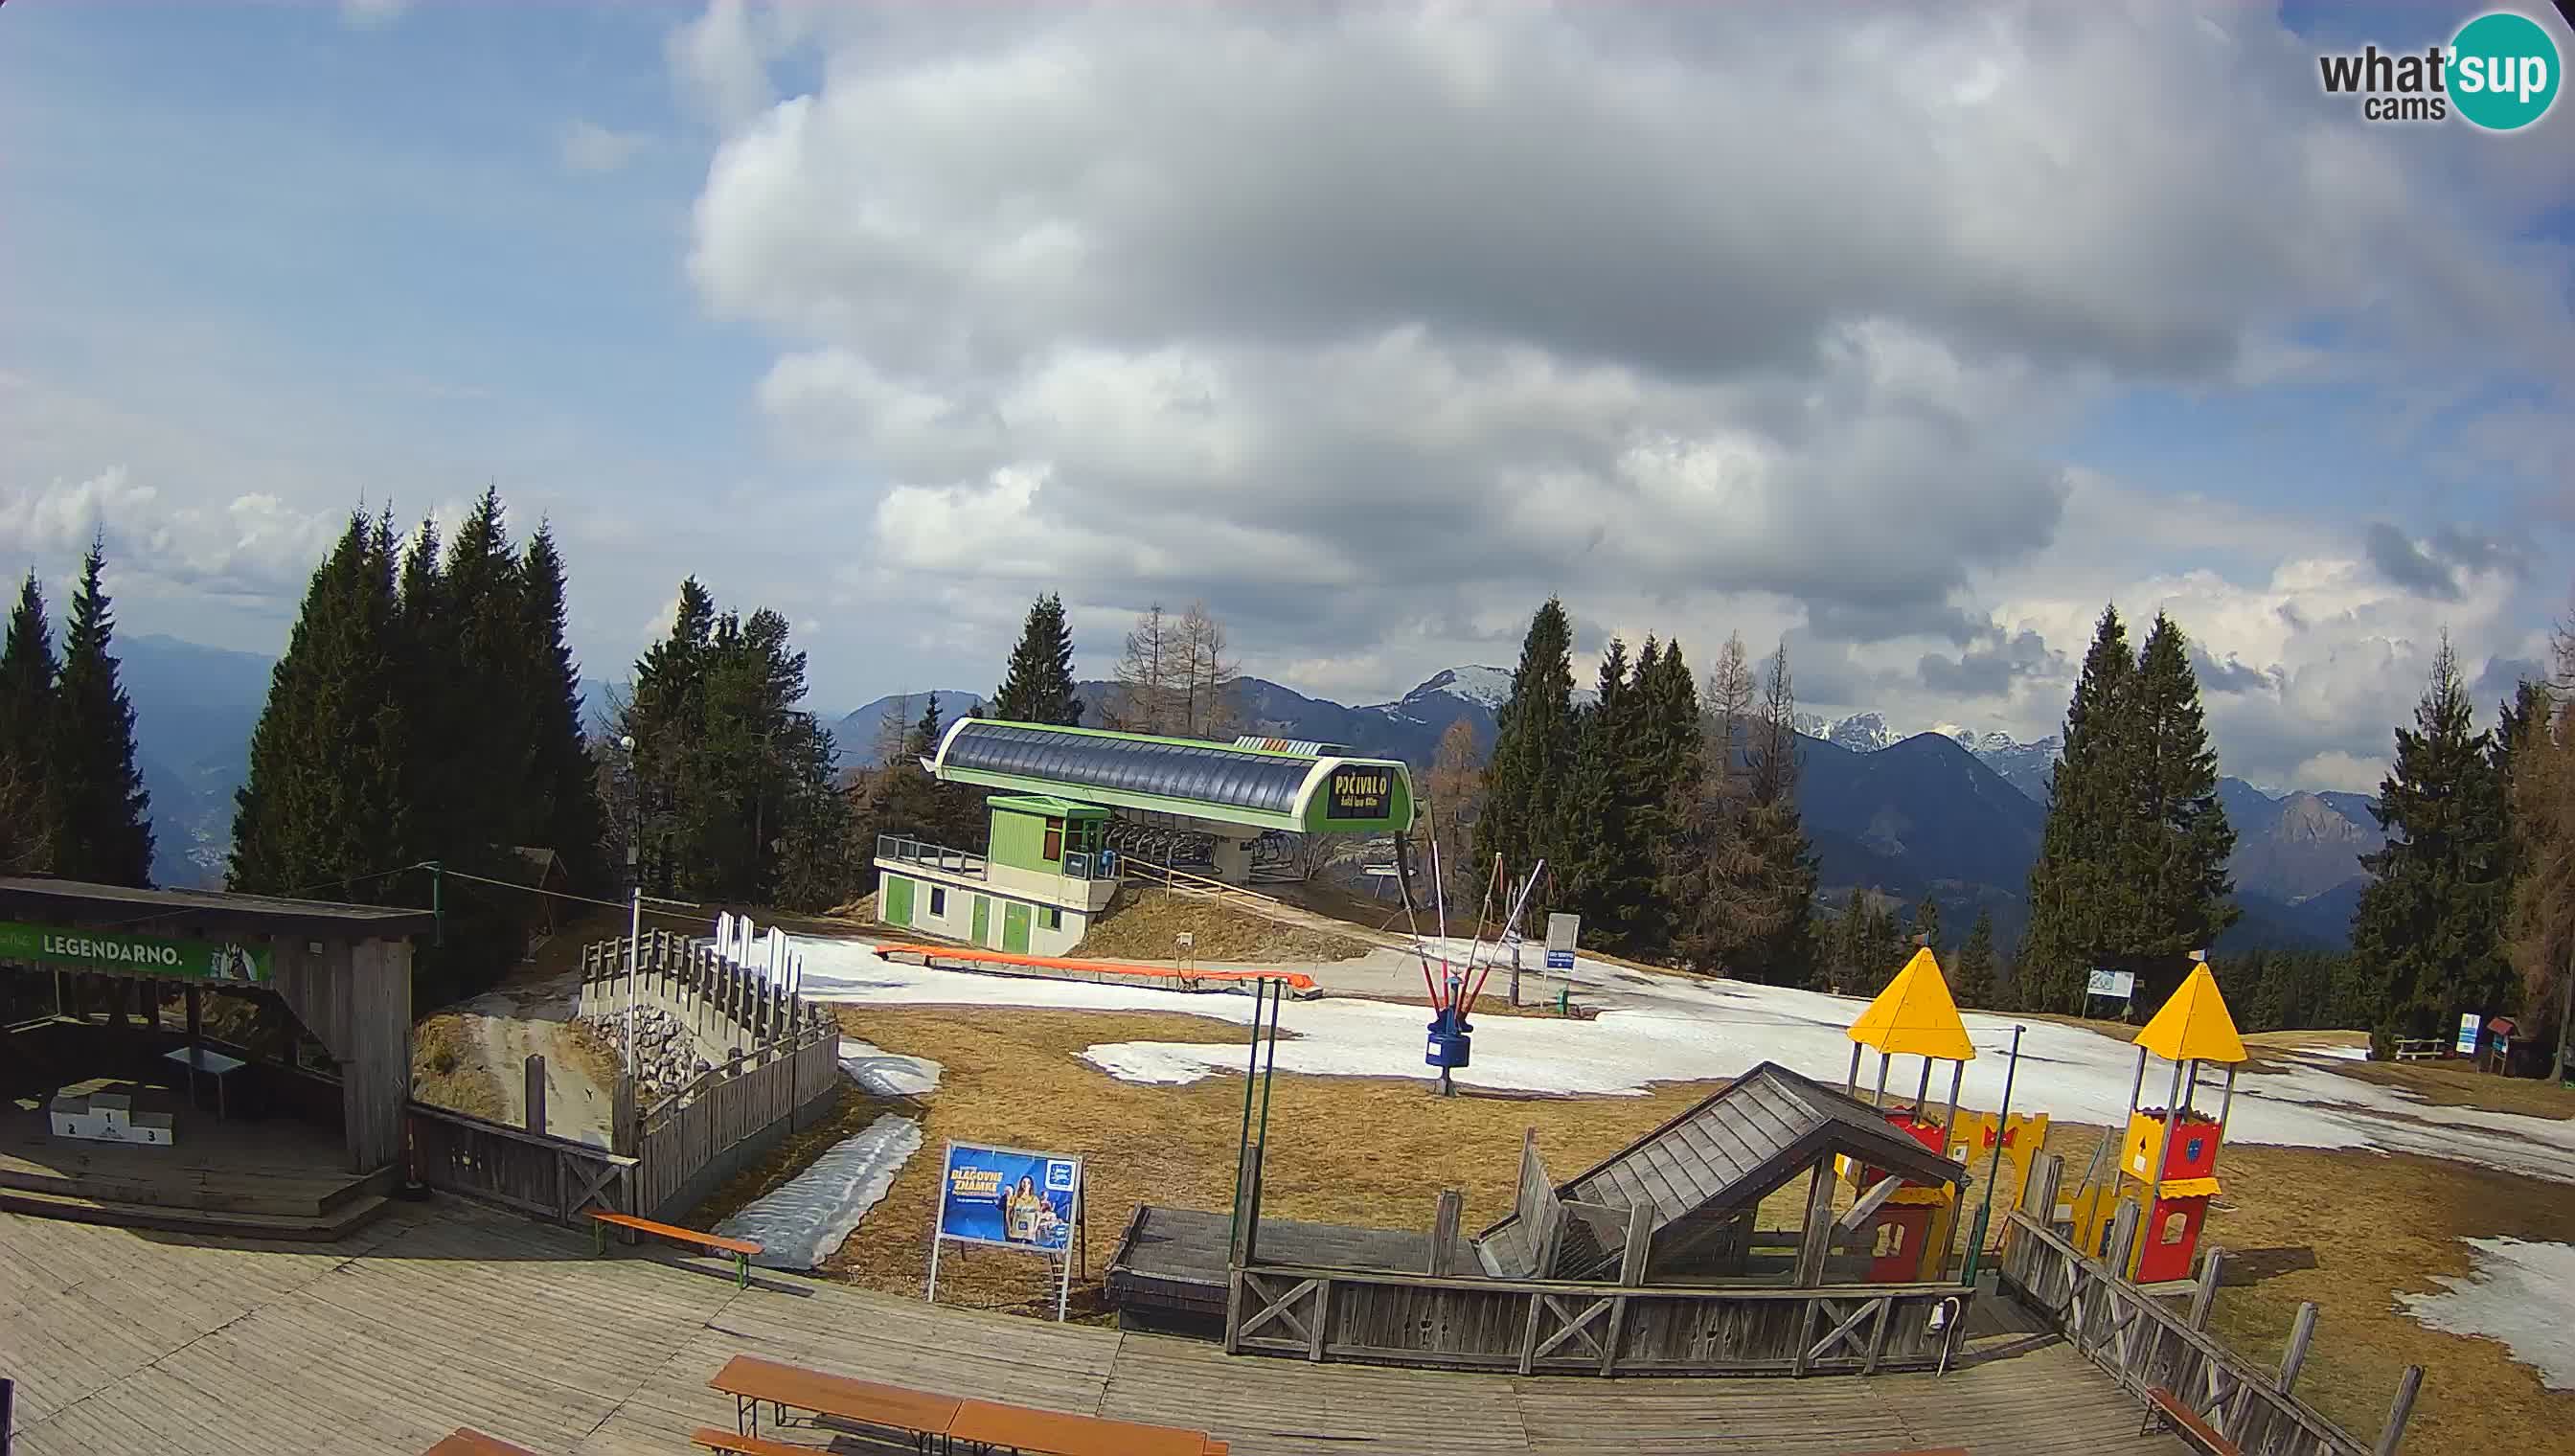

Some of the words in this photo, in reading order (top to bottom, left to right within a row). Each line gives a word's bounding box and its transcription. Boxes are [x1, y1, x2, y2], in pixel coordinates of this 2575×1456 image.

[43, 934, 184, 967] LEGENDARNO.
[105, 1112, 112, 1124] 1
[68, 1124, 76, 1135] 2
[148, 1130, 156, 1142] 3
